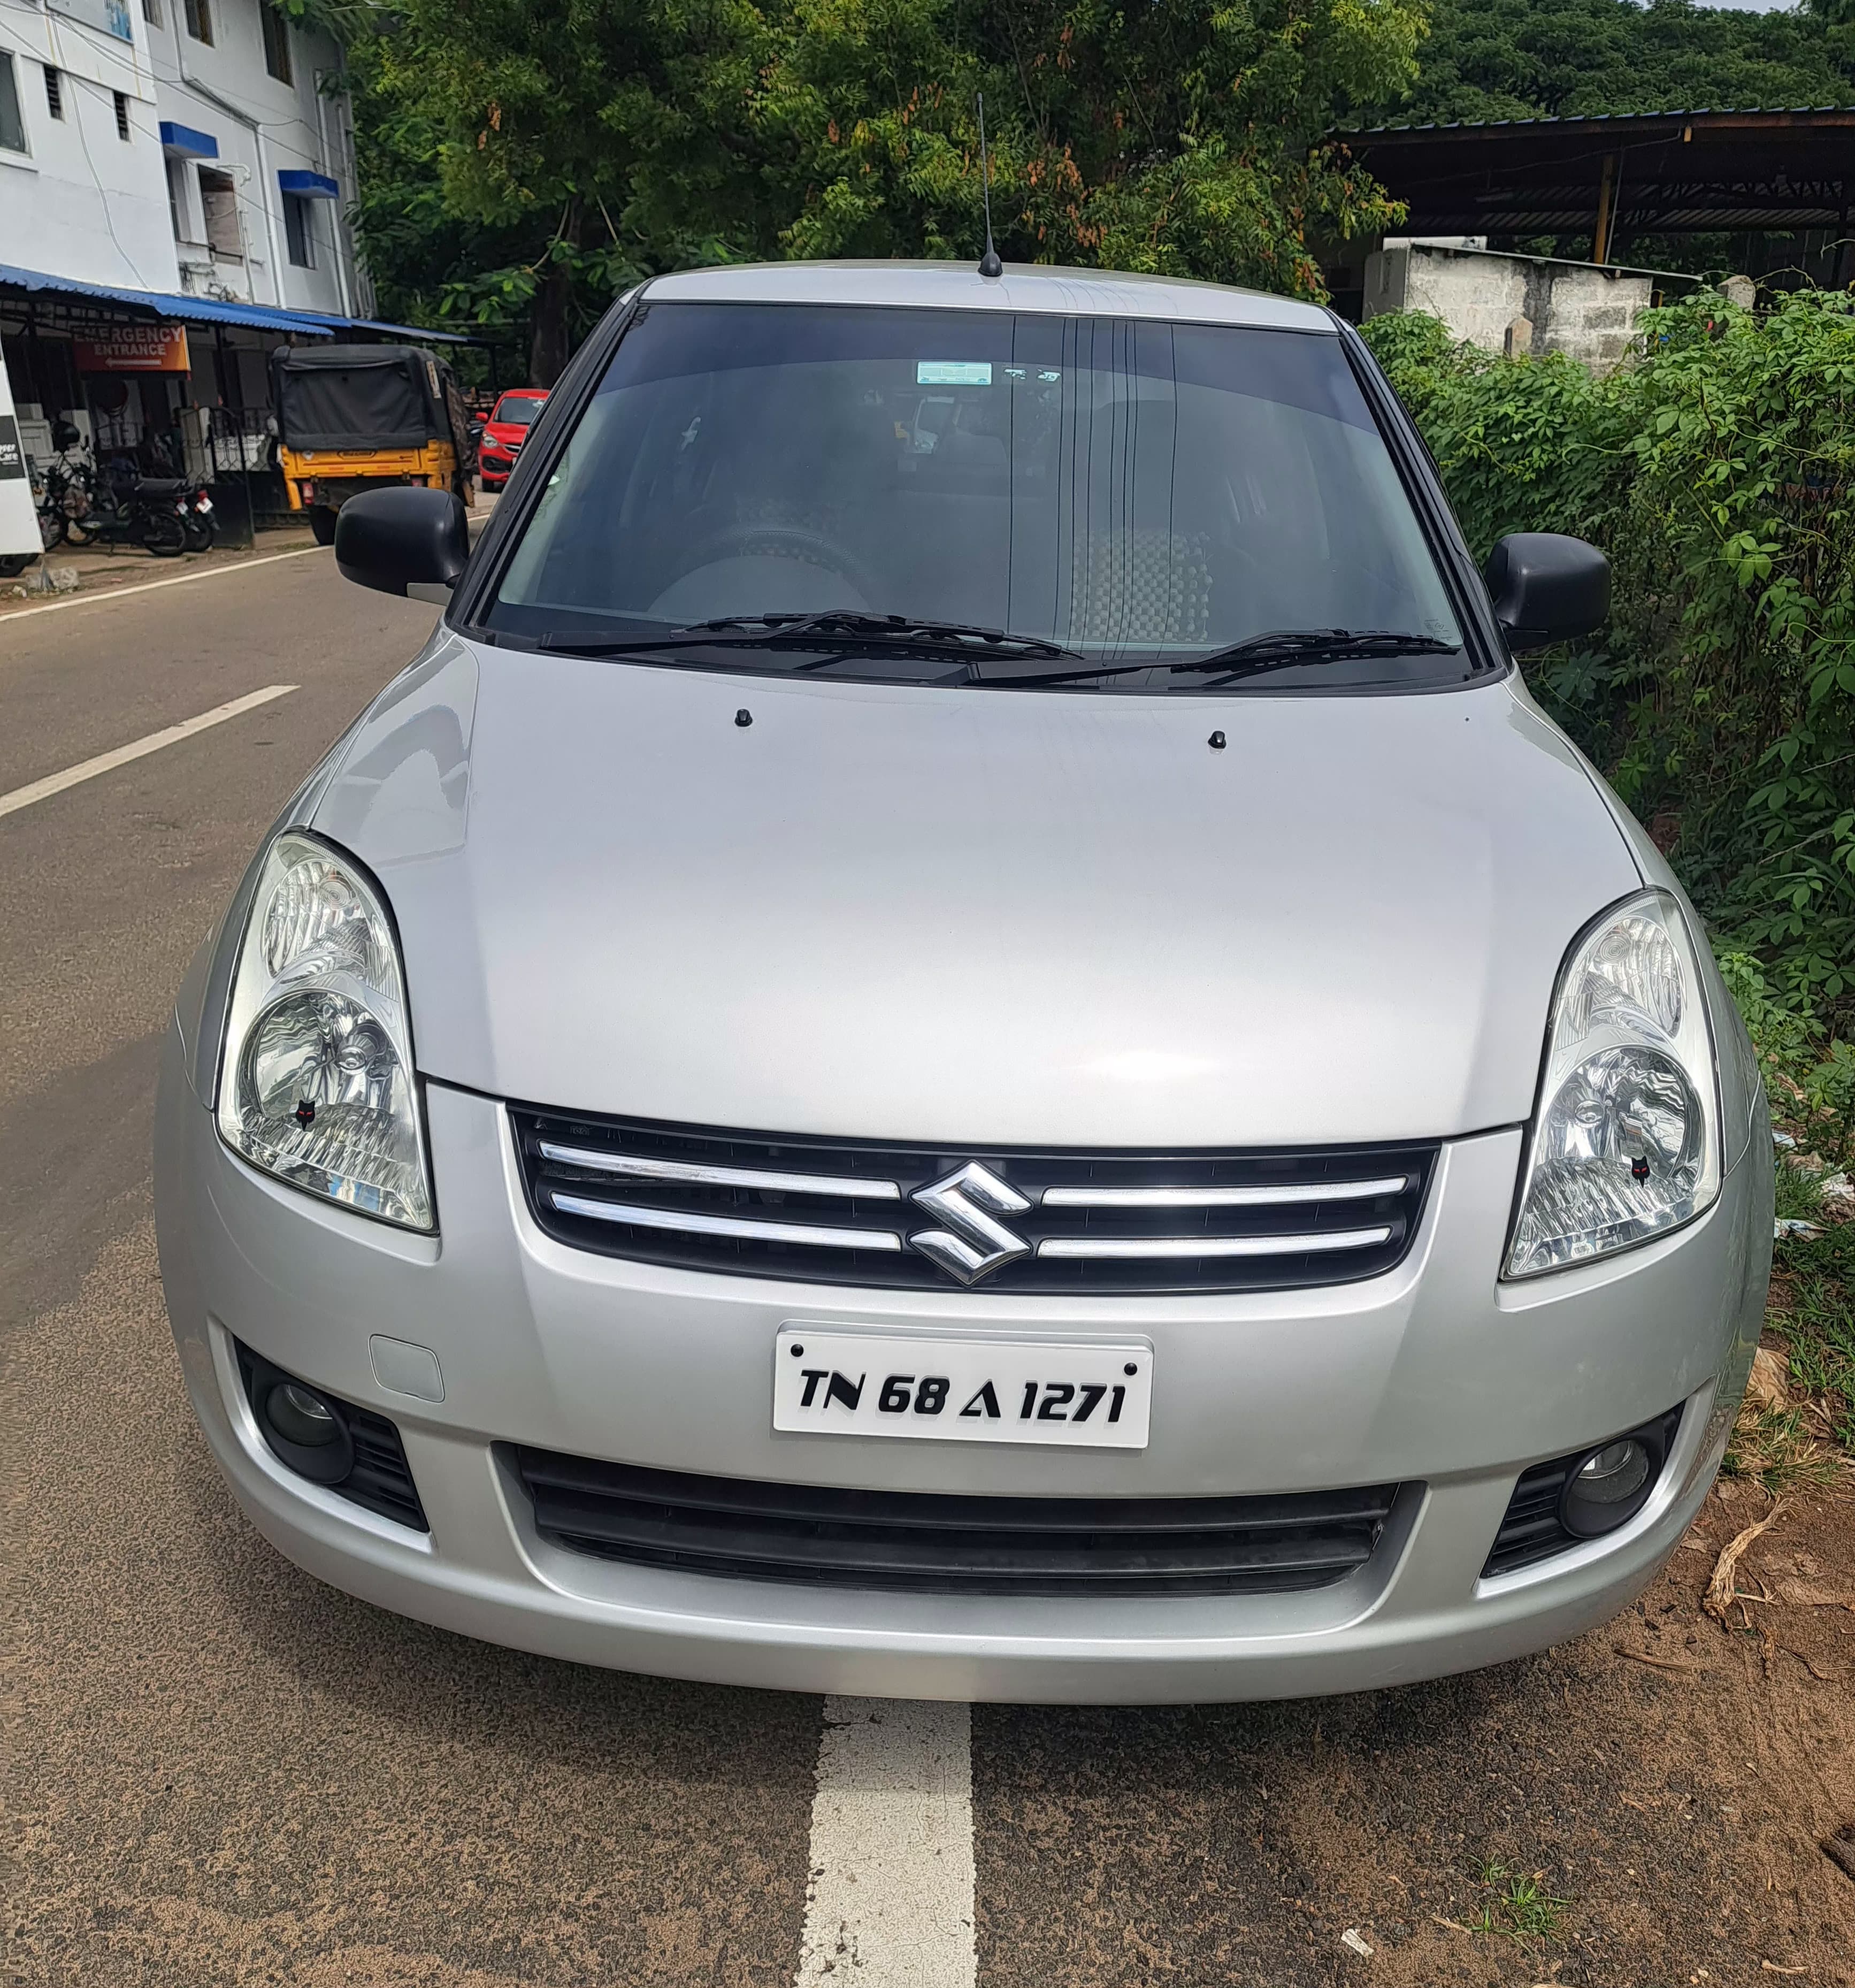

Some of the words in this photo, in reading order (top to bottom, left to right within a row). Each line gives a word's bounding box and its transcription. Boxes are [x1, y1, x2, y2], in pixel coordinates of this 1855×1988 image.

[73, 327, 181, 342] EMERGENCY
[94, 344, 167, 356] ENTRANCE
[800, 1369, 866, 1410] TN
[878, 1373, 950, 1415] 68
[959, 1379, 1001, 1418] A
[1020, 1380, 1126, 1423] 1271
